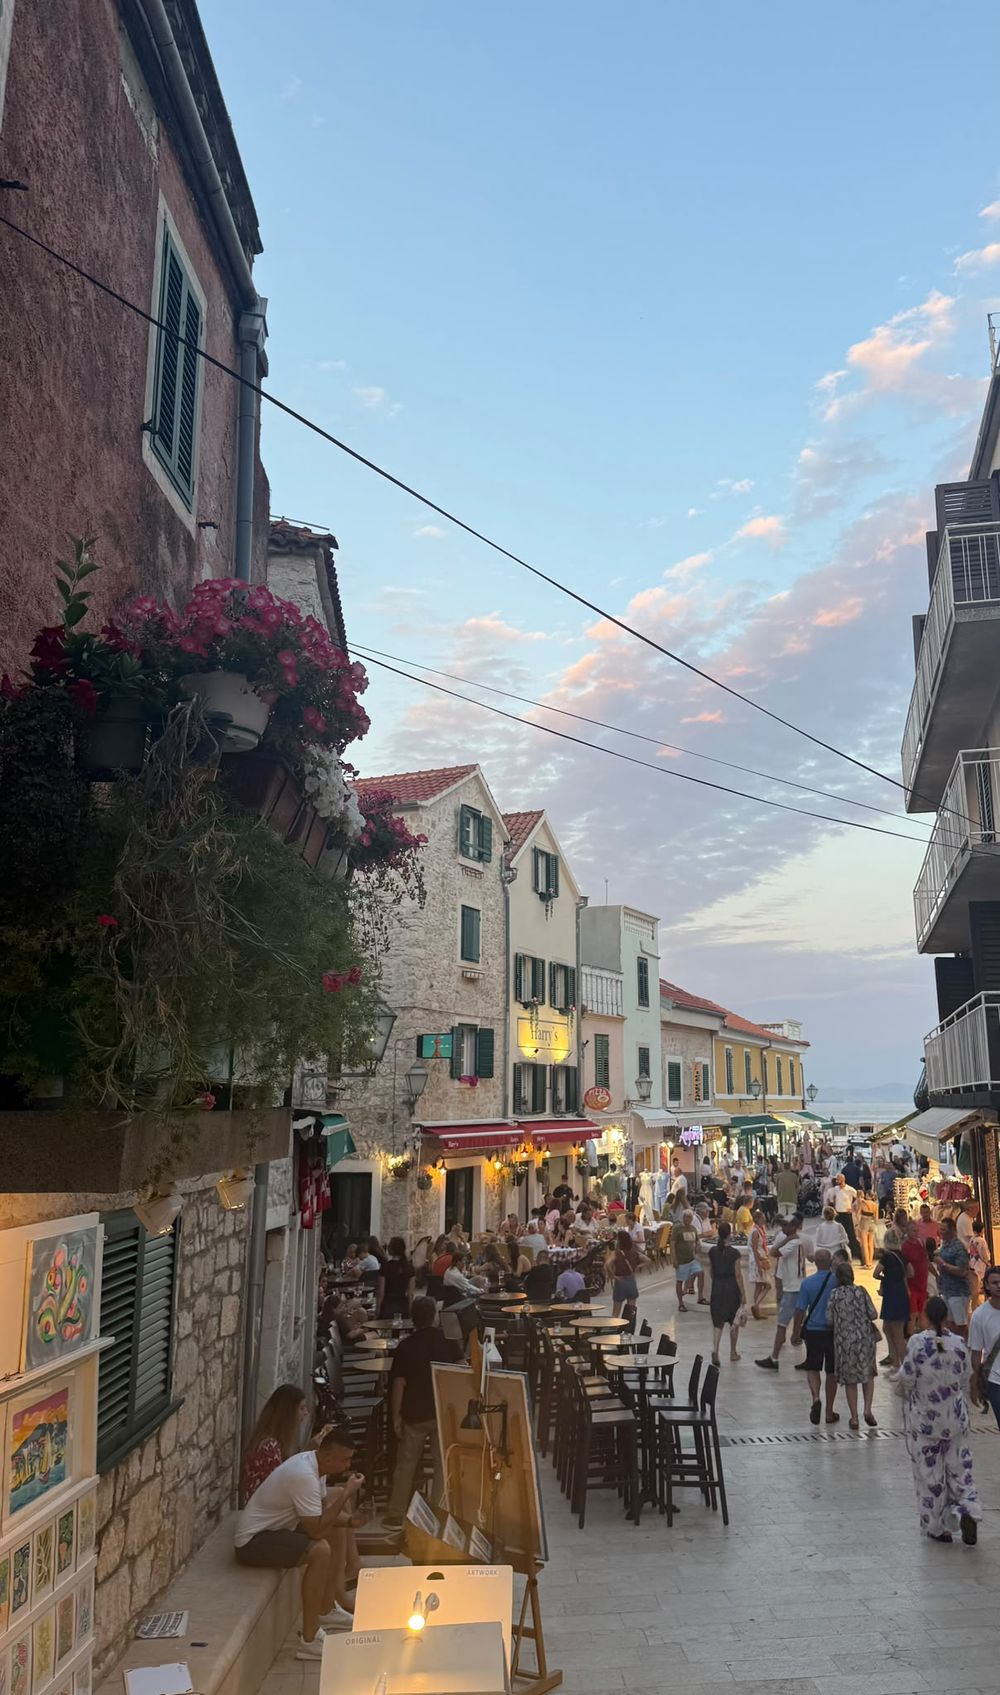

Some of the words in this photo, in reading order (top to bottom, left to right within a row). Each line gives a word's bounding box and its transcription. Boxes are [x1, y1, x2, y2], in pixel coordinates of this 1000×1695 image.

[530, 1026, 559, 1047] Harry's
[588, 1087, 607, 1096] PIZZA
[345, 1635, 381, 1646] ORIGINAL
